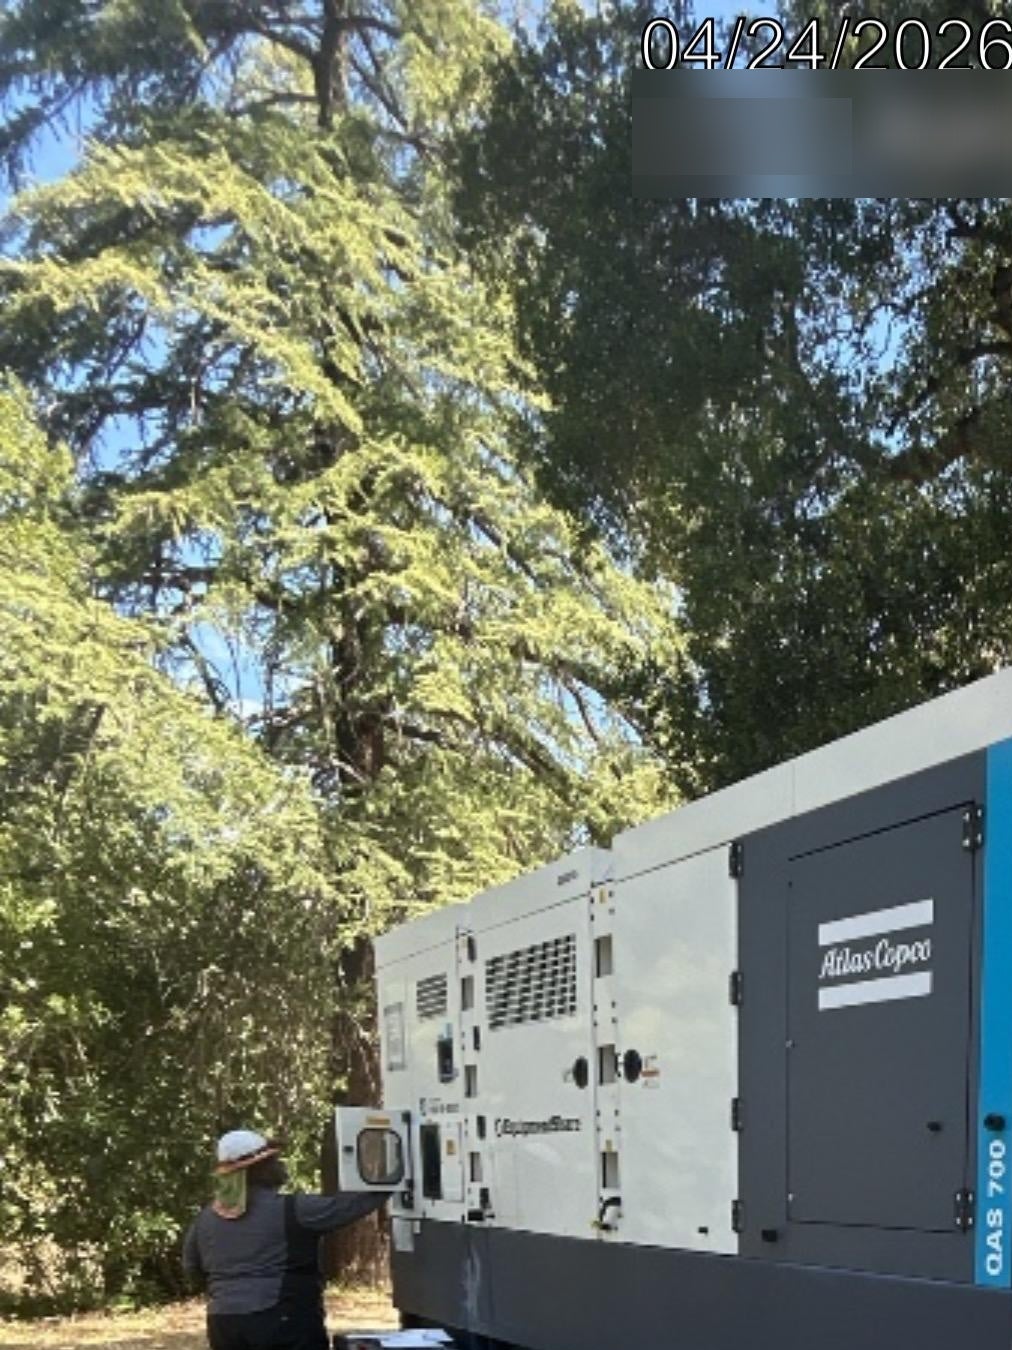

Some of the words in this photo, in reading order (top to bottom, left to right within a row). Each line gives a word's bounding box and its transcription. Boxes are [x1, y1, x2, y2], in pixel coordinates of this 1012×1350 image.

[819, 946, 874, 979] Atlas
[875, 938, 931, 973] Copco
[986, 1139, 1006, 1198] 700
[985, 1208, 1004, 1276] QAS
